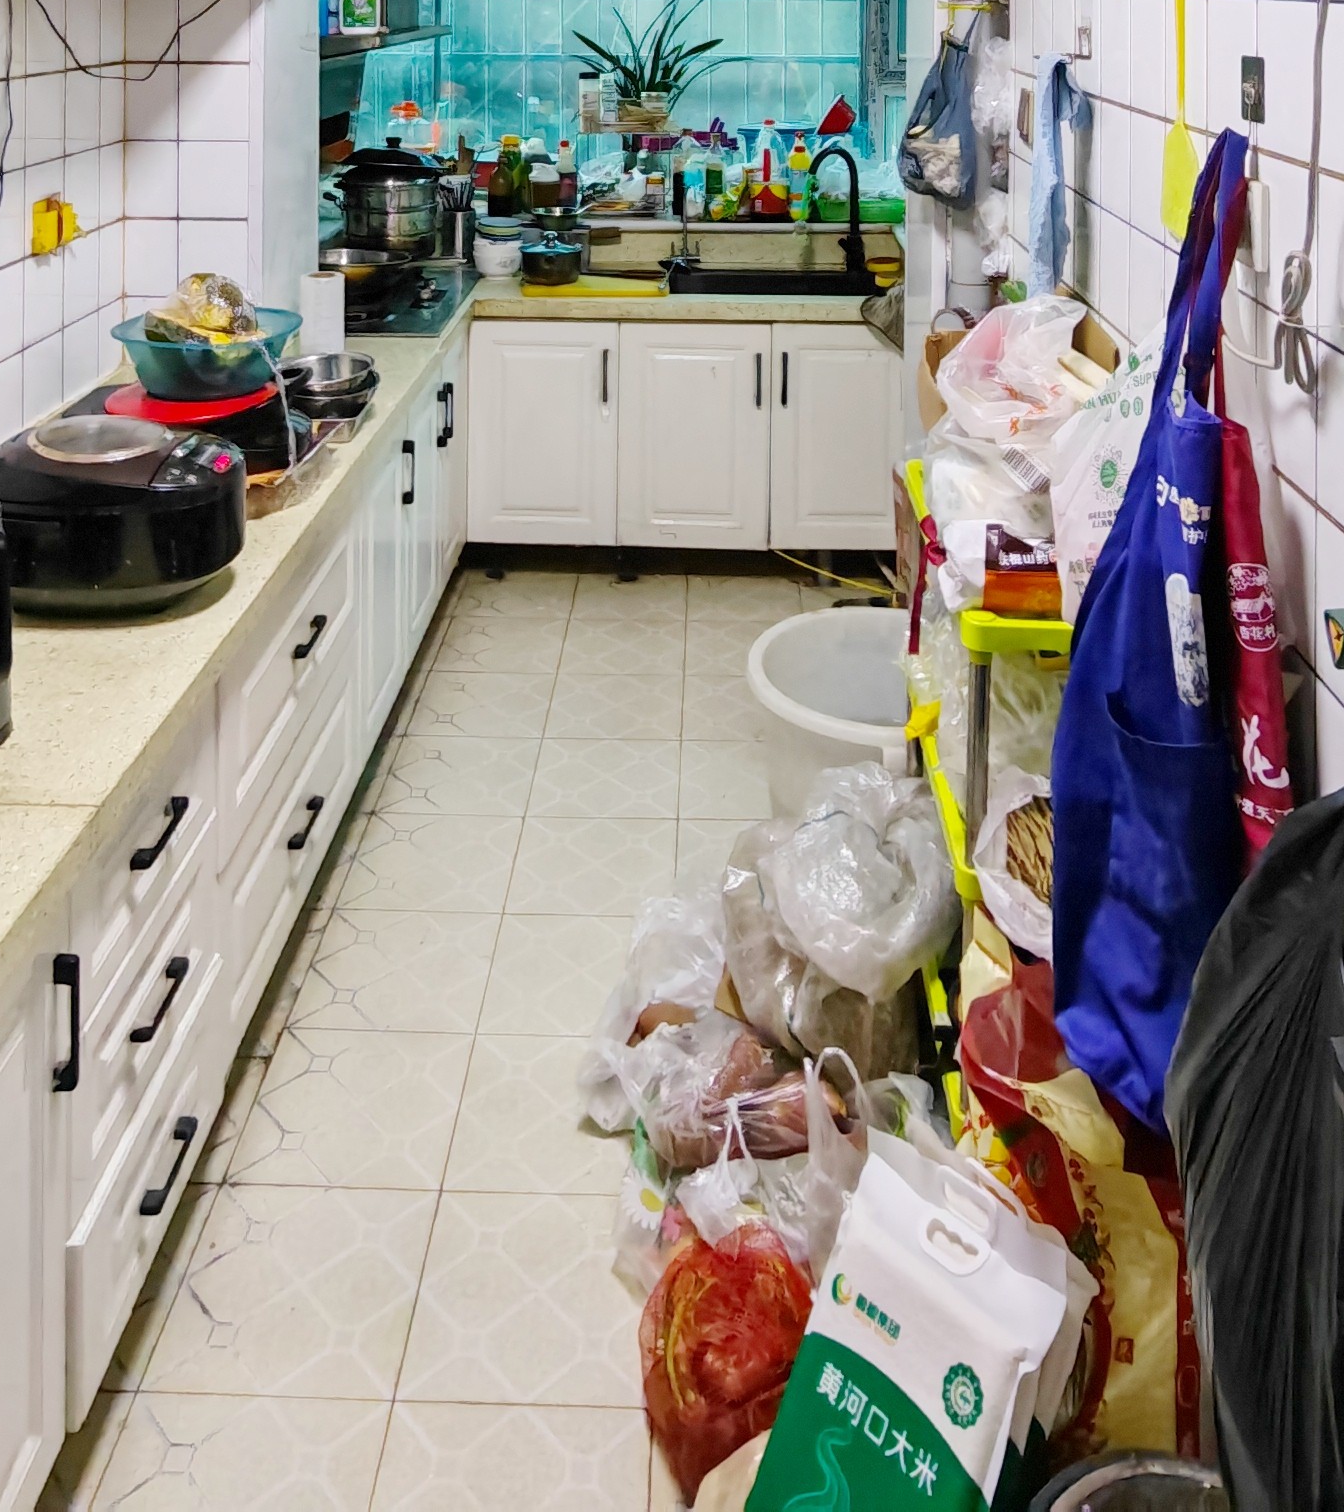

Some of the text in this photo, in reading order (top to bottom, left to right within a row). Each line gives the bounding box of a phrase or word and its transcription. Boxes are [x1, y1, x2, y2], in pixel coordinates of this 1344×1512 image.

[816, 1361, 939, 1497] 黄河口大米
